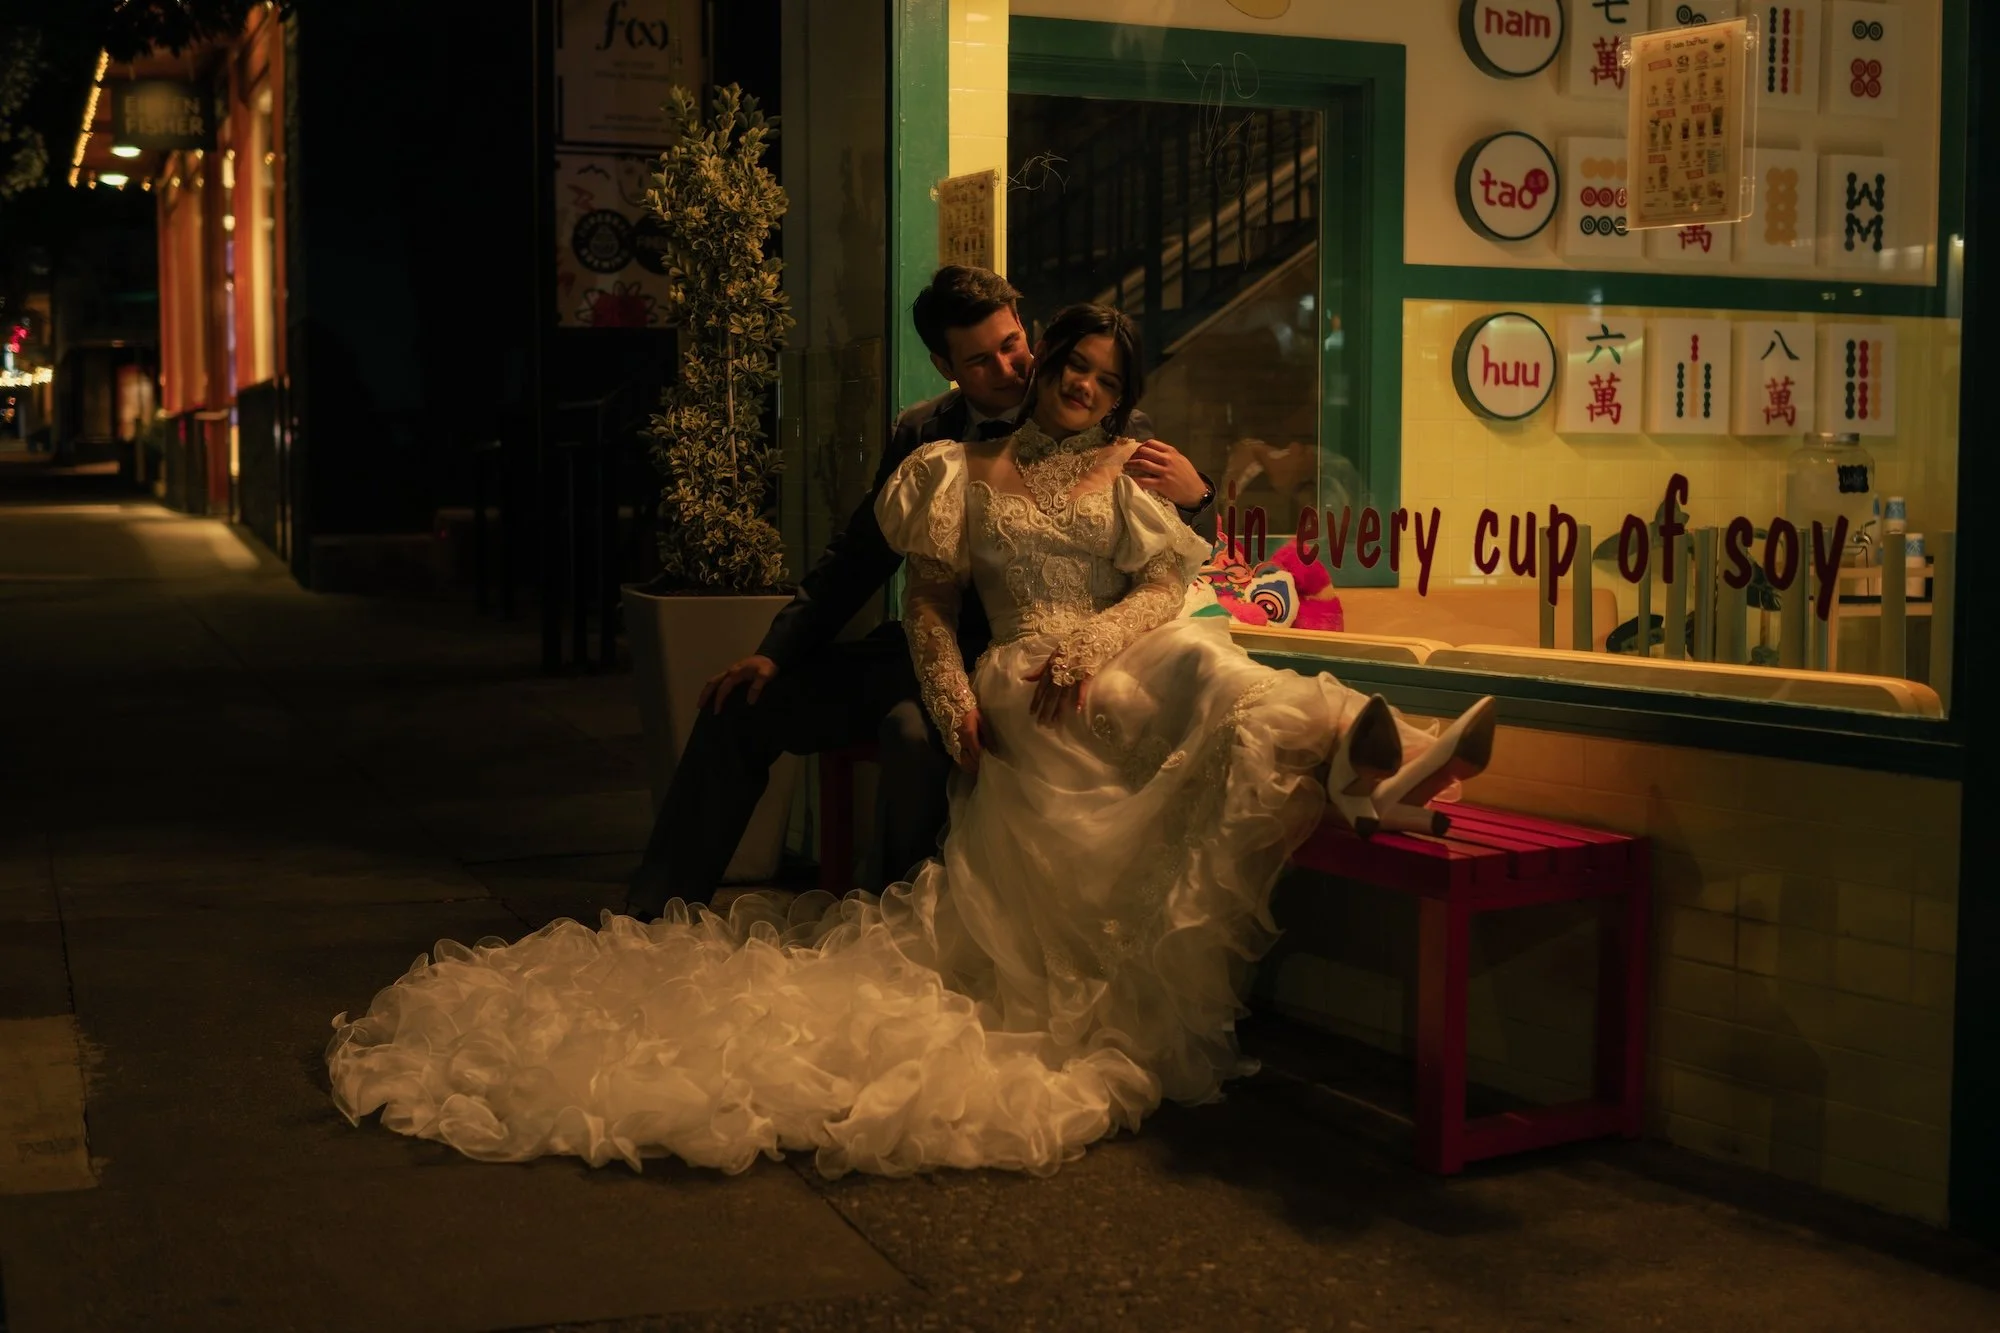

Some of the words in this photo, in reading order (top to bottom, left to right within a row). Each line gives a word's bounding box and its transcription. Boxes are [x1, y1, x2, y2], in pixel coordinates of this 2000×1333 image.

[1484, 6, 1552, 39] nam
[1479, 168, 1542, 211] tao
[1481, 344, 1541, 389] huu
[1586, 323, 1627, 426] 六萬
[1760, 329, 1801, 428] 八萬
[1226, 479, 1267, 565] in
[1296, 504, 1442, 597] every
[1474, 503, 1578, 607] cup
[1618, 473, 1689, 585] of
[1723, 514, 1849, 622] soy
